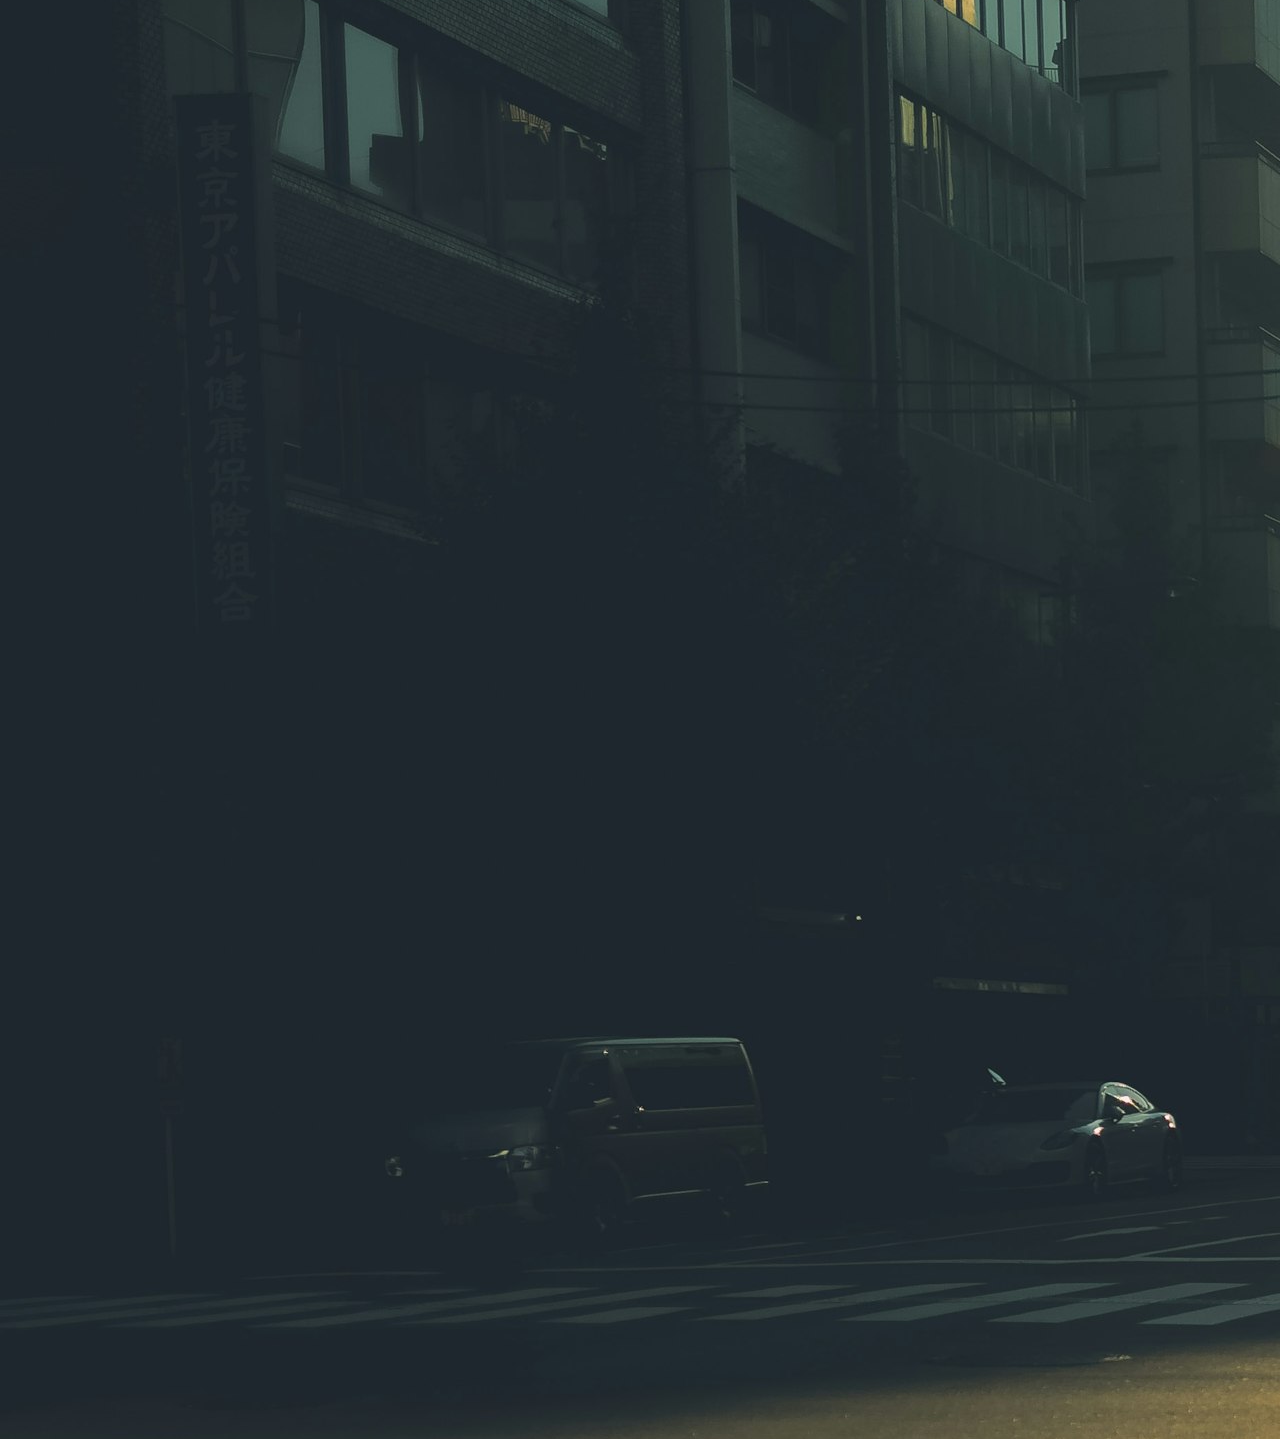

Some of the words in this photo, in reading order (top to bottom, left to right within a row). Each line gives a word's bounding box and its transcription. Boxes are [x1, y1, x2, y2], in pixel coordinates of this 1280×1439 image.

[194, 119, 260, 624] 東京アパレル健康保険組合
